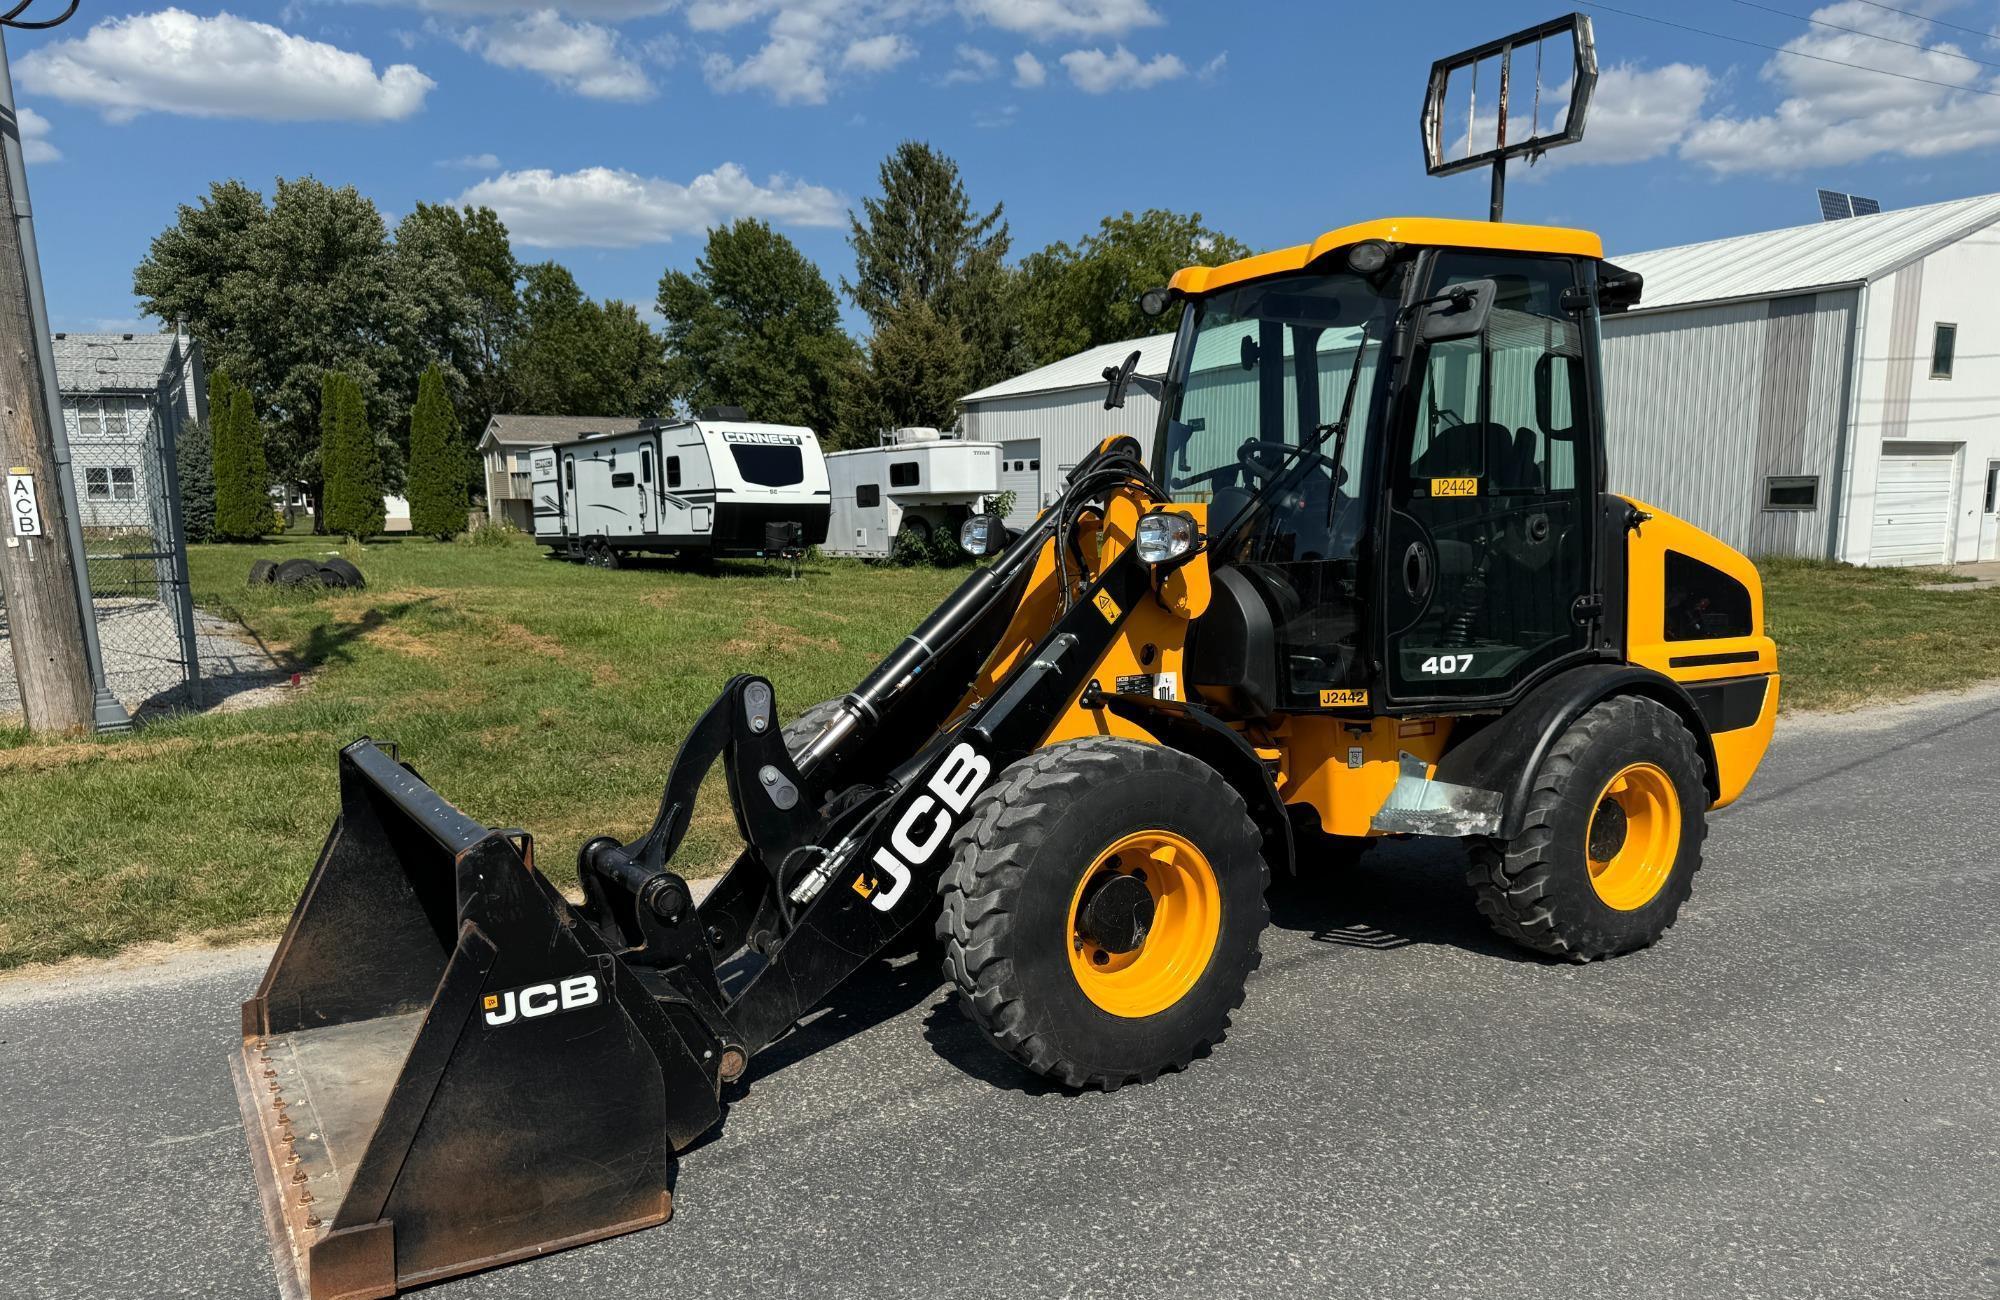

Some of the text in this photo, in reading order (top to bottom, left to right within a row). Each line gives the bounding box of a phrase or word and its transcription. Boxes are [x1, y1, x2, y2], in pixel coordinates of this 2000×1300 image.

[723, 432, 800, 445] CONNECT
[1434, 479, 1475, 495] J2442
[1421, 654, 1474, 675] 407
[1322, 692, 1364, 704] J2442
[871, 743, 991, 912] JCB
[485, 975, 599, 1026] JCB
